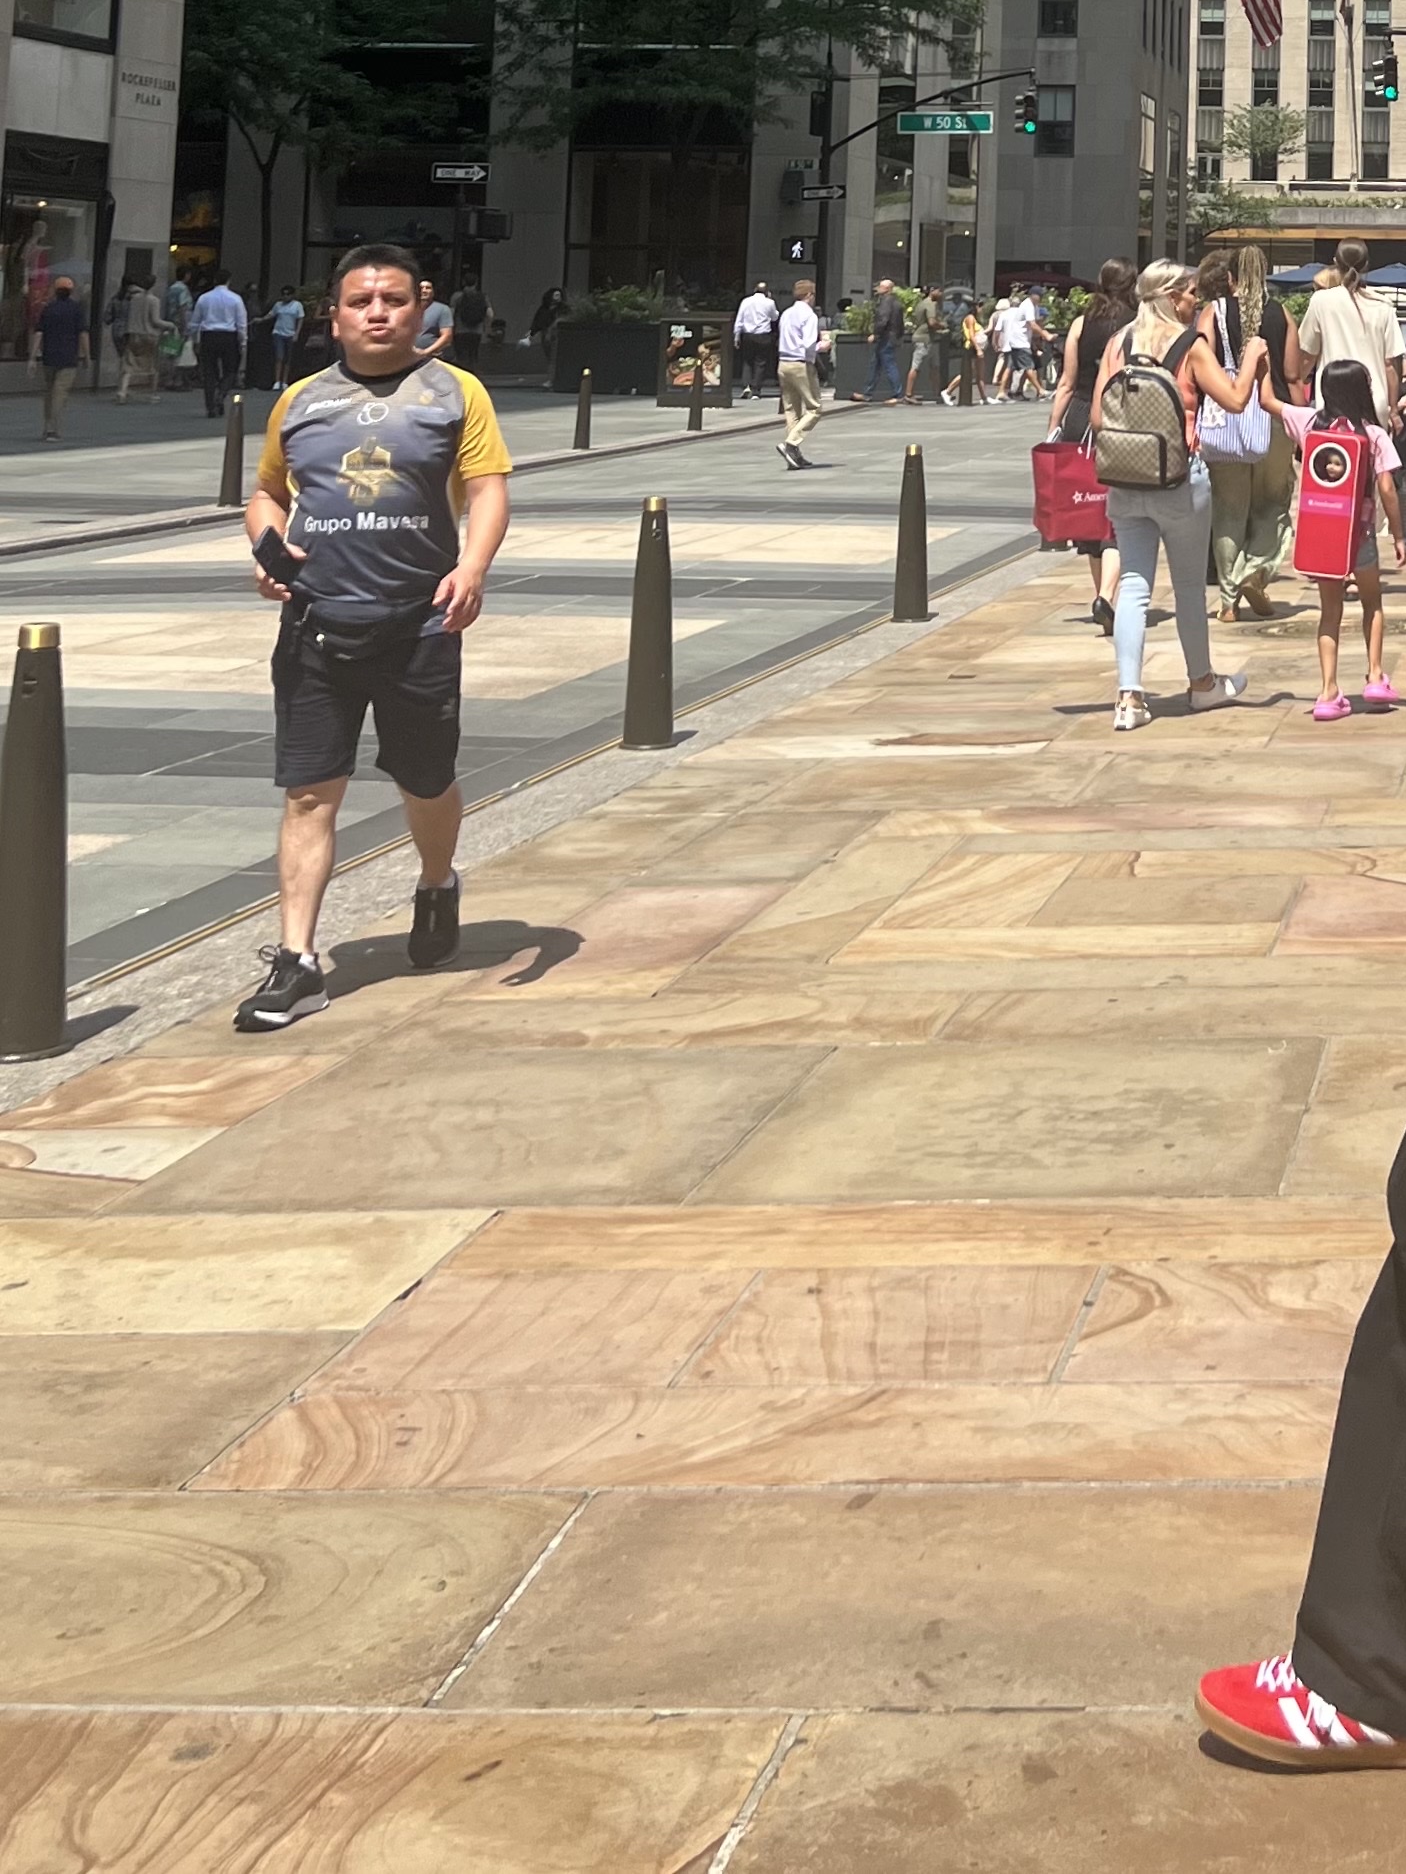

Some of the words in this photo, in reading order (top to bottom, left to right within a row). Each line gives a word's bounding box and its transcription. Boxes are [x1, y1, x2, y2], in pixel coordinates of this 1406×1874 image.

[923, 116, 933, 129] W
[936, 116, 951, 129] 50
[304, 516, 352, 535] Grupo
